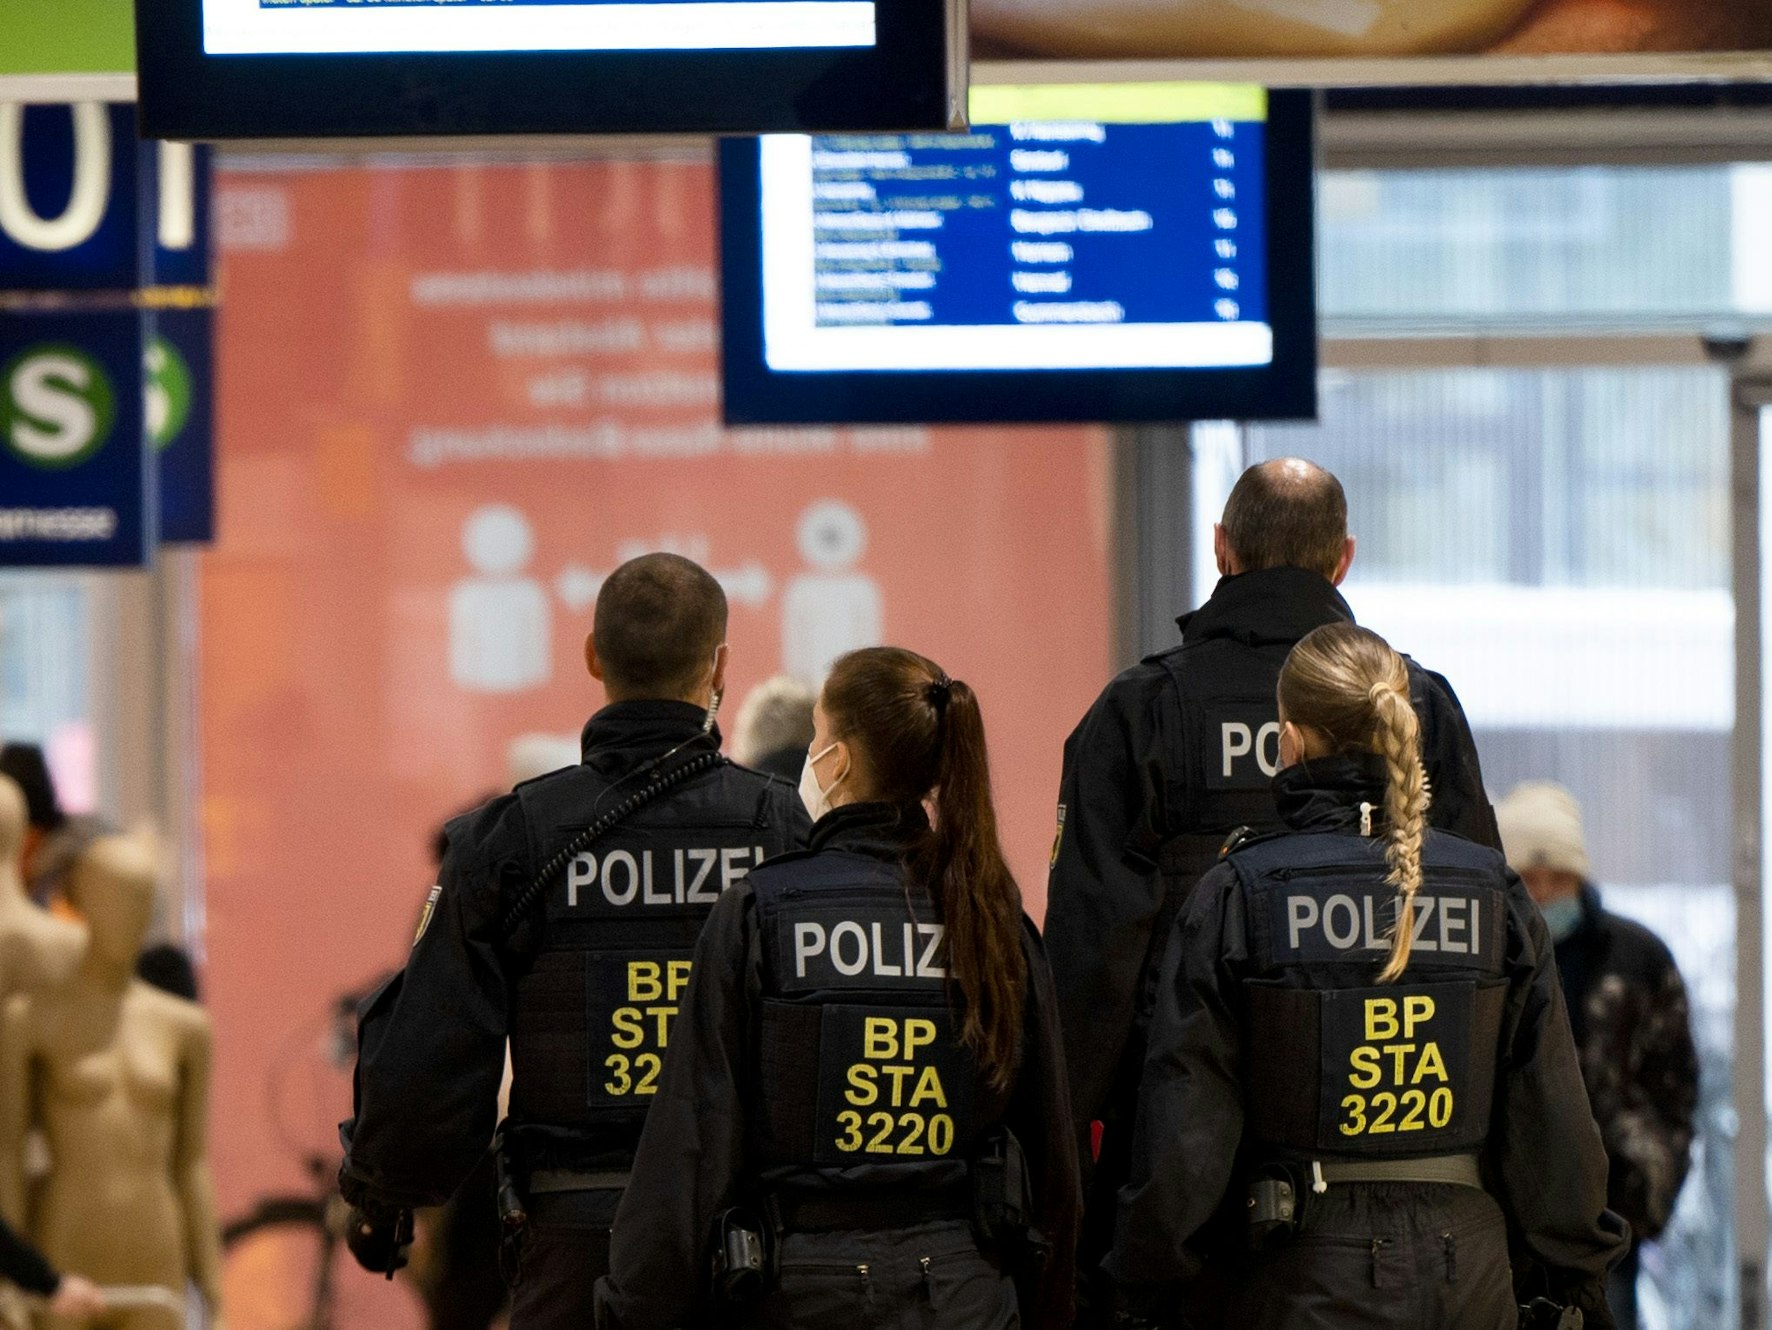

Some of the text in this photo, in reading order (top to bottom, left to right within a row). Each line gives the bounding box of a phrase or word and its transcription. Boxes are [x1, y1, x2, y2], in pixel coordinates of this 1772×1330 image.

[10, 351, 97, 459] S
[1287, 893, 1480, 955] POLIZEI
[794, 920, 948, 978] POLIZ
[627, 960, 693, 1002] BP
[611, 1006, 679, 1049] ST
[864, 1016, 937, 1061] BP
[1364, 995, 1436, 1041] BP
[605, 1052, 662, 1096] 32
[844, 1064, 948, 1108] STA
[1348, 1042, 1449, 1089] STA
[835, 1110, 954, 1156] 3220
[1339, 1087, 1454, 1136] 3220
